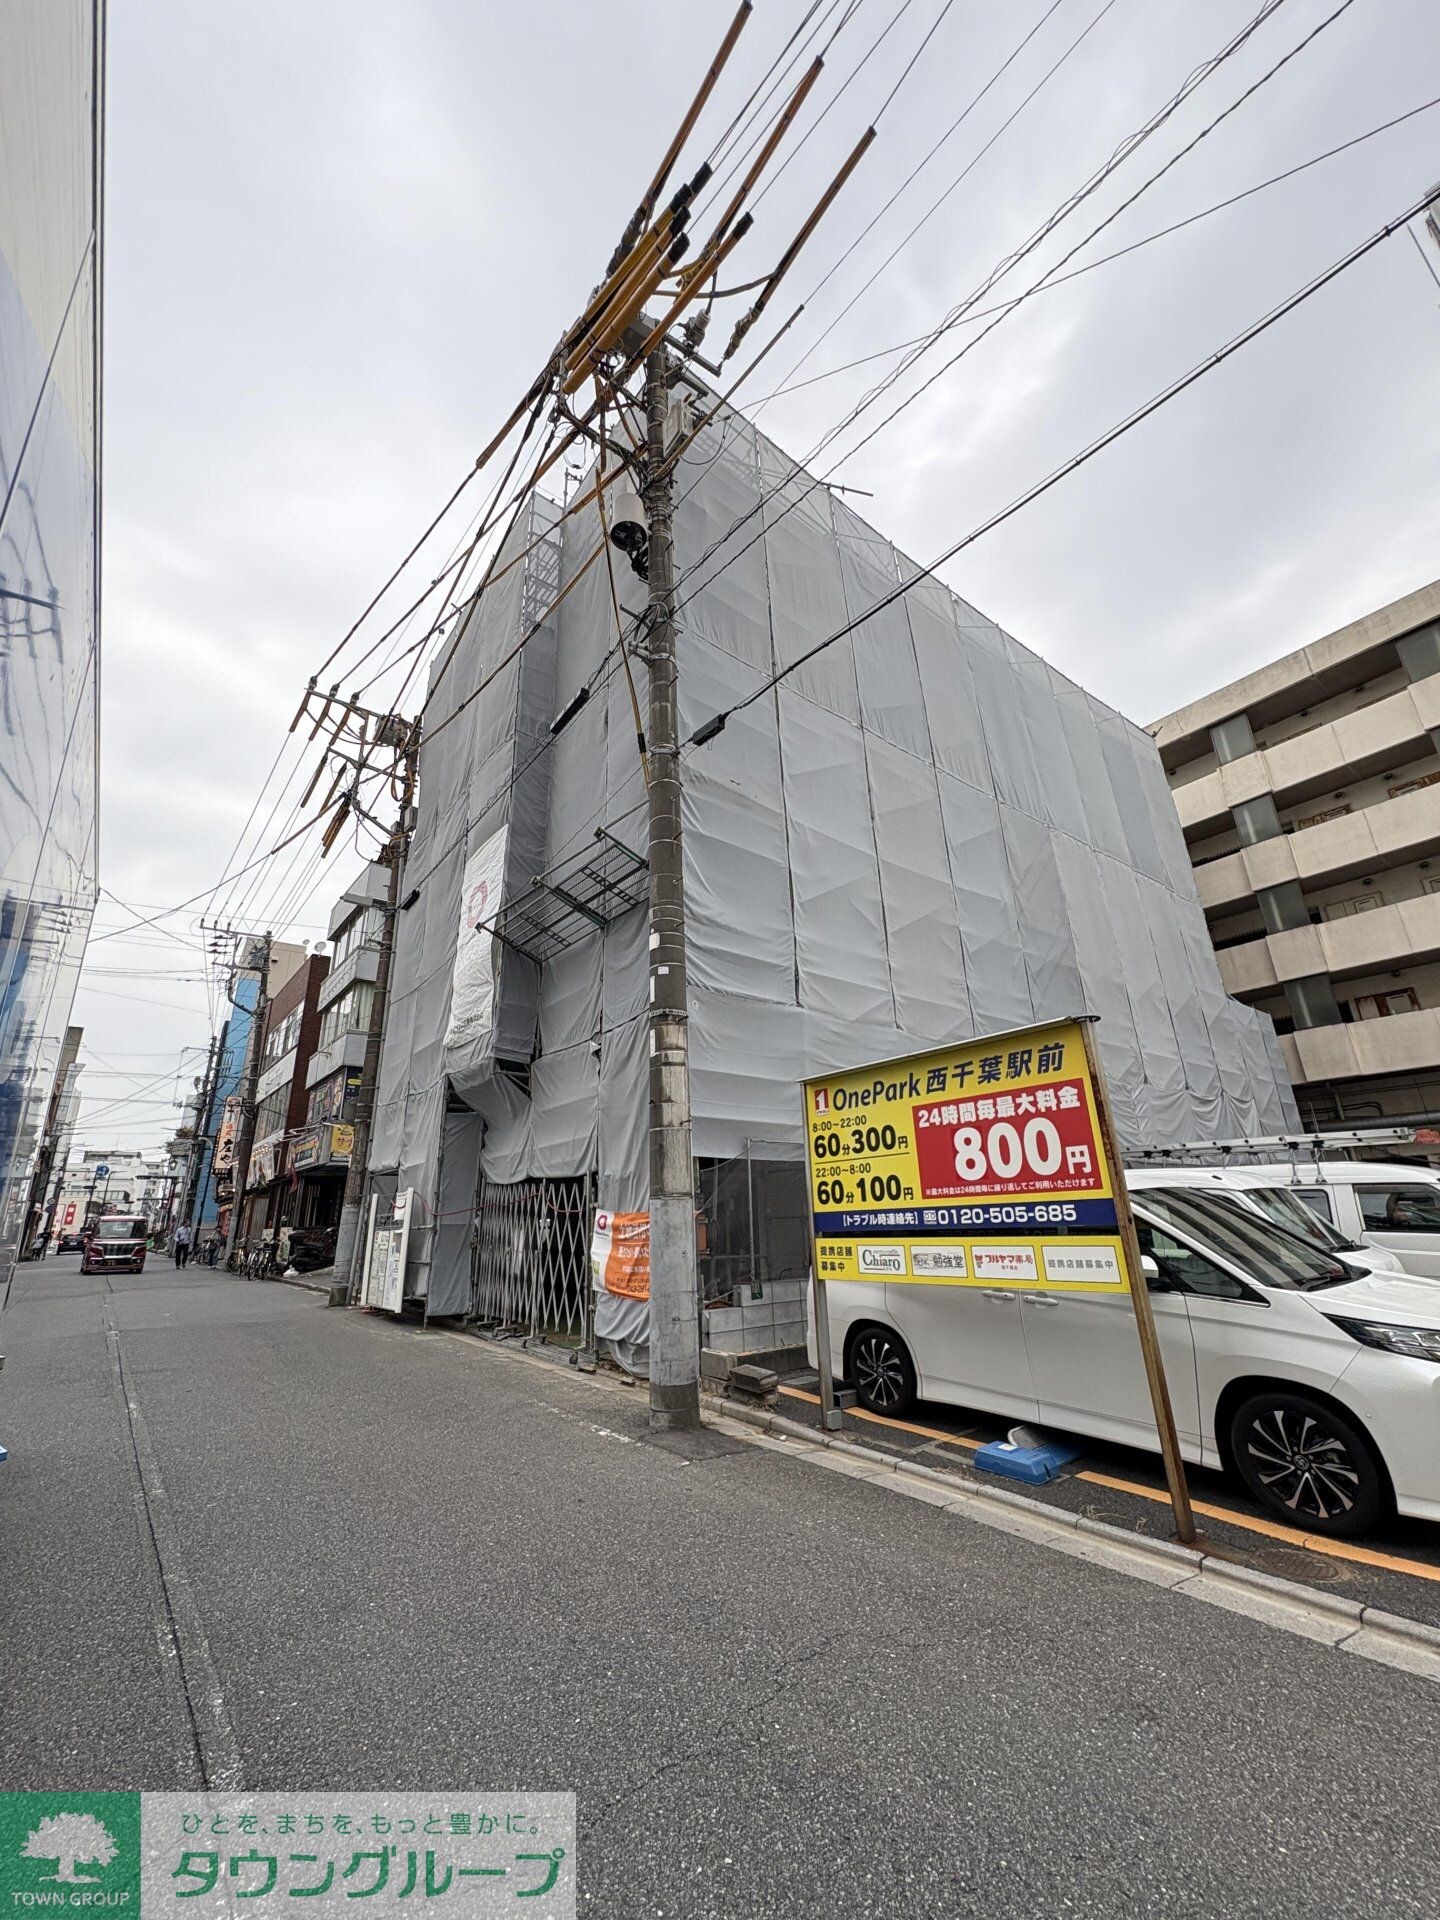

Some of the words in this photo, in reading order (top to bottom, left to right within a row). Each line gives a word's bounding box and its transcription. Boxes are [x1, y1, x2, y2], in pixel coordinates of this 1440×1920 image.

[833, 1072, 921, 1111] OnePark
[926, 1042, 1065, 1094] 西千葉駅前
[918, 1086, 1081, 1128] 24時間毎最大料金
[953, 1117, 1092, 1181] 800円
[937, 1204, 1077, 1225] 0120-505-685
[863, 1249, 900, 1271] Chiaro
